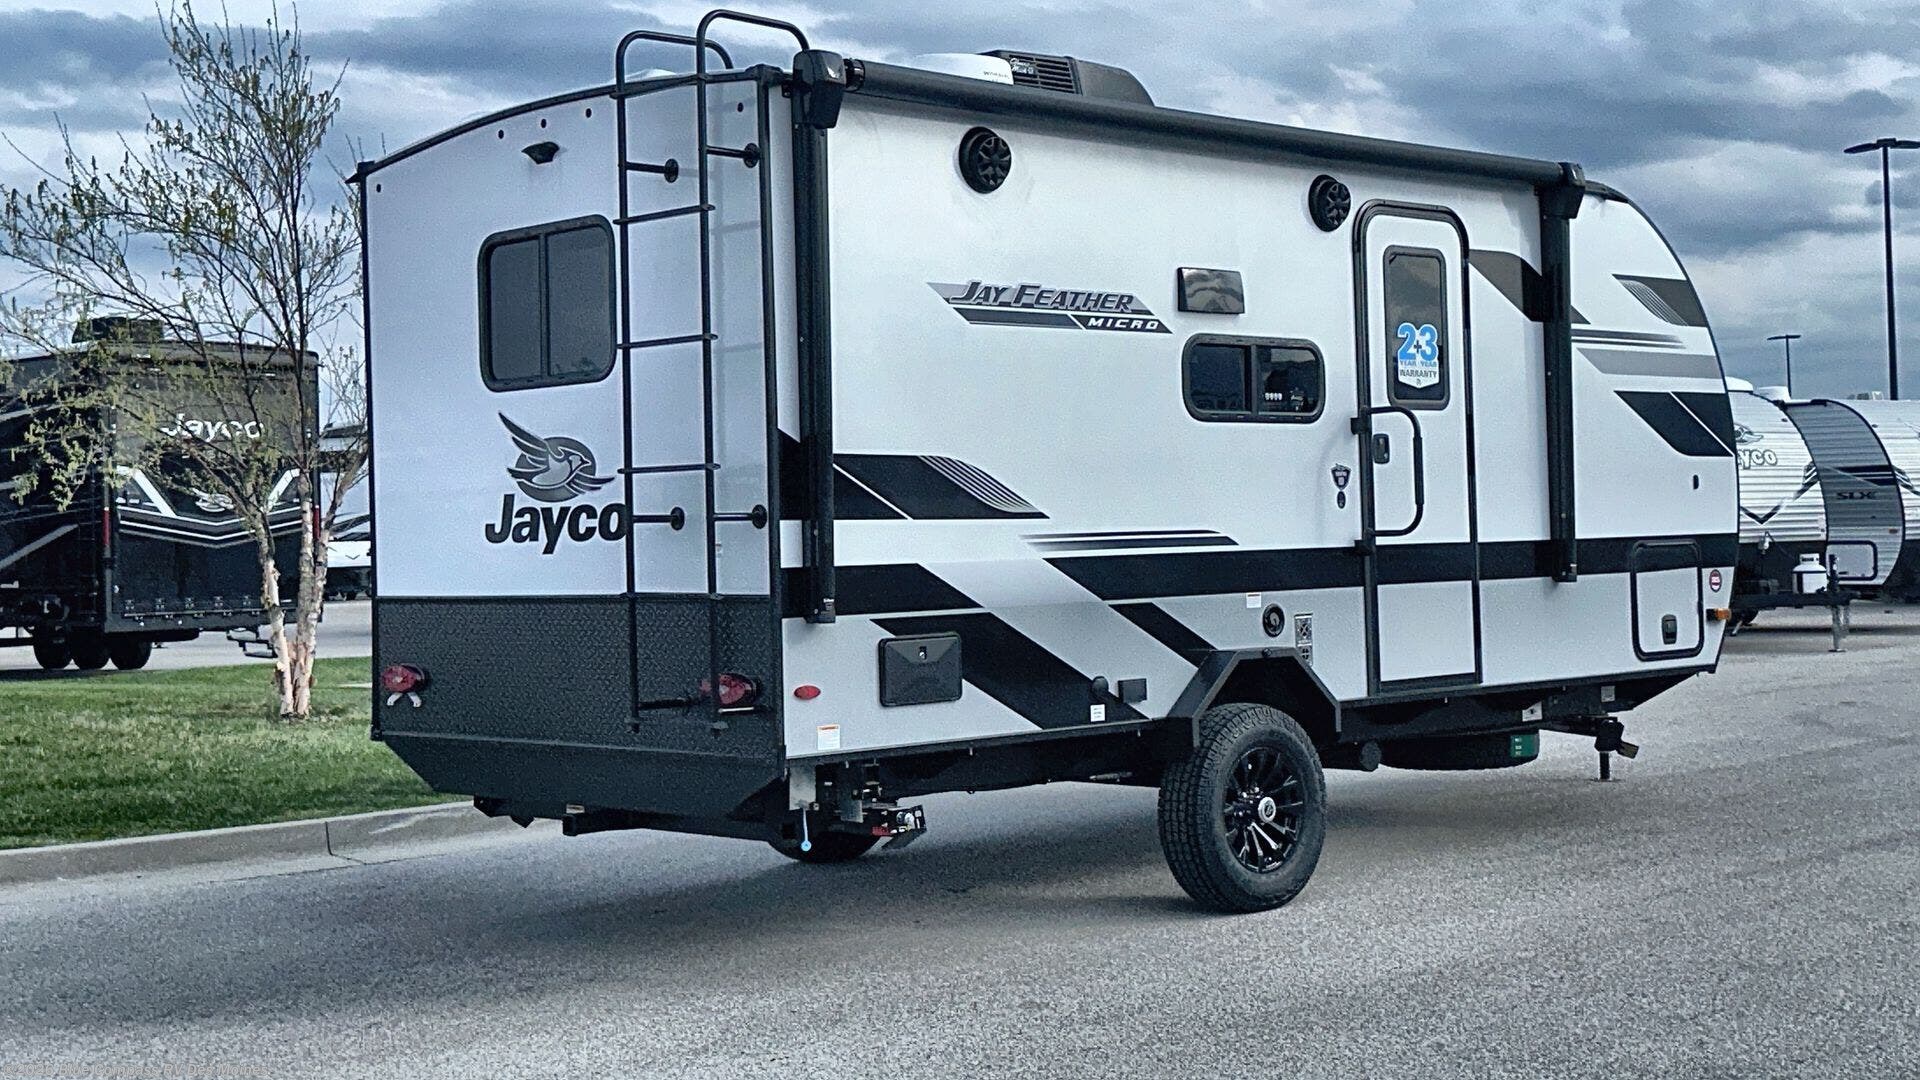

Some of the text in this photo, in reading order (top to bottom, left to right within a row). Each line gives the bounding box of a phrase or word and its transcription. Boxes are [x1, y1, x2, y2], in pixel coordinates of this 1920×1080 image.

[950, 280, 1135, 312] JAY FEATHER
[1087, 317, 1159, 330] MICRO
[1399, 368, 1437, 378] WARRANTY
[484, 493, 628, 555] Jayco
